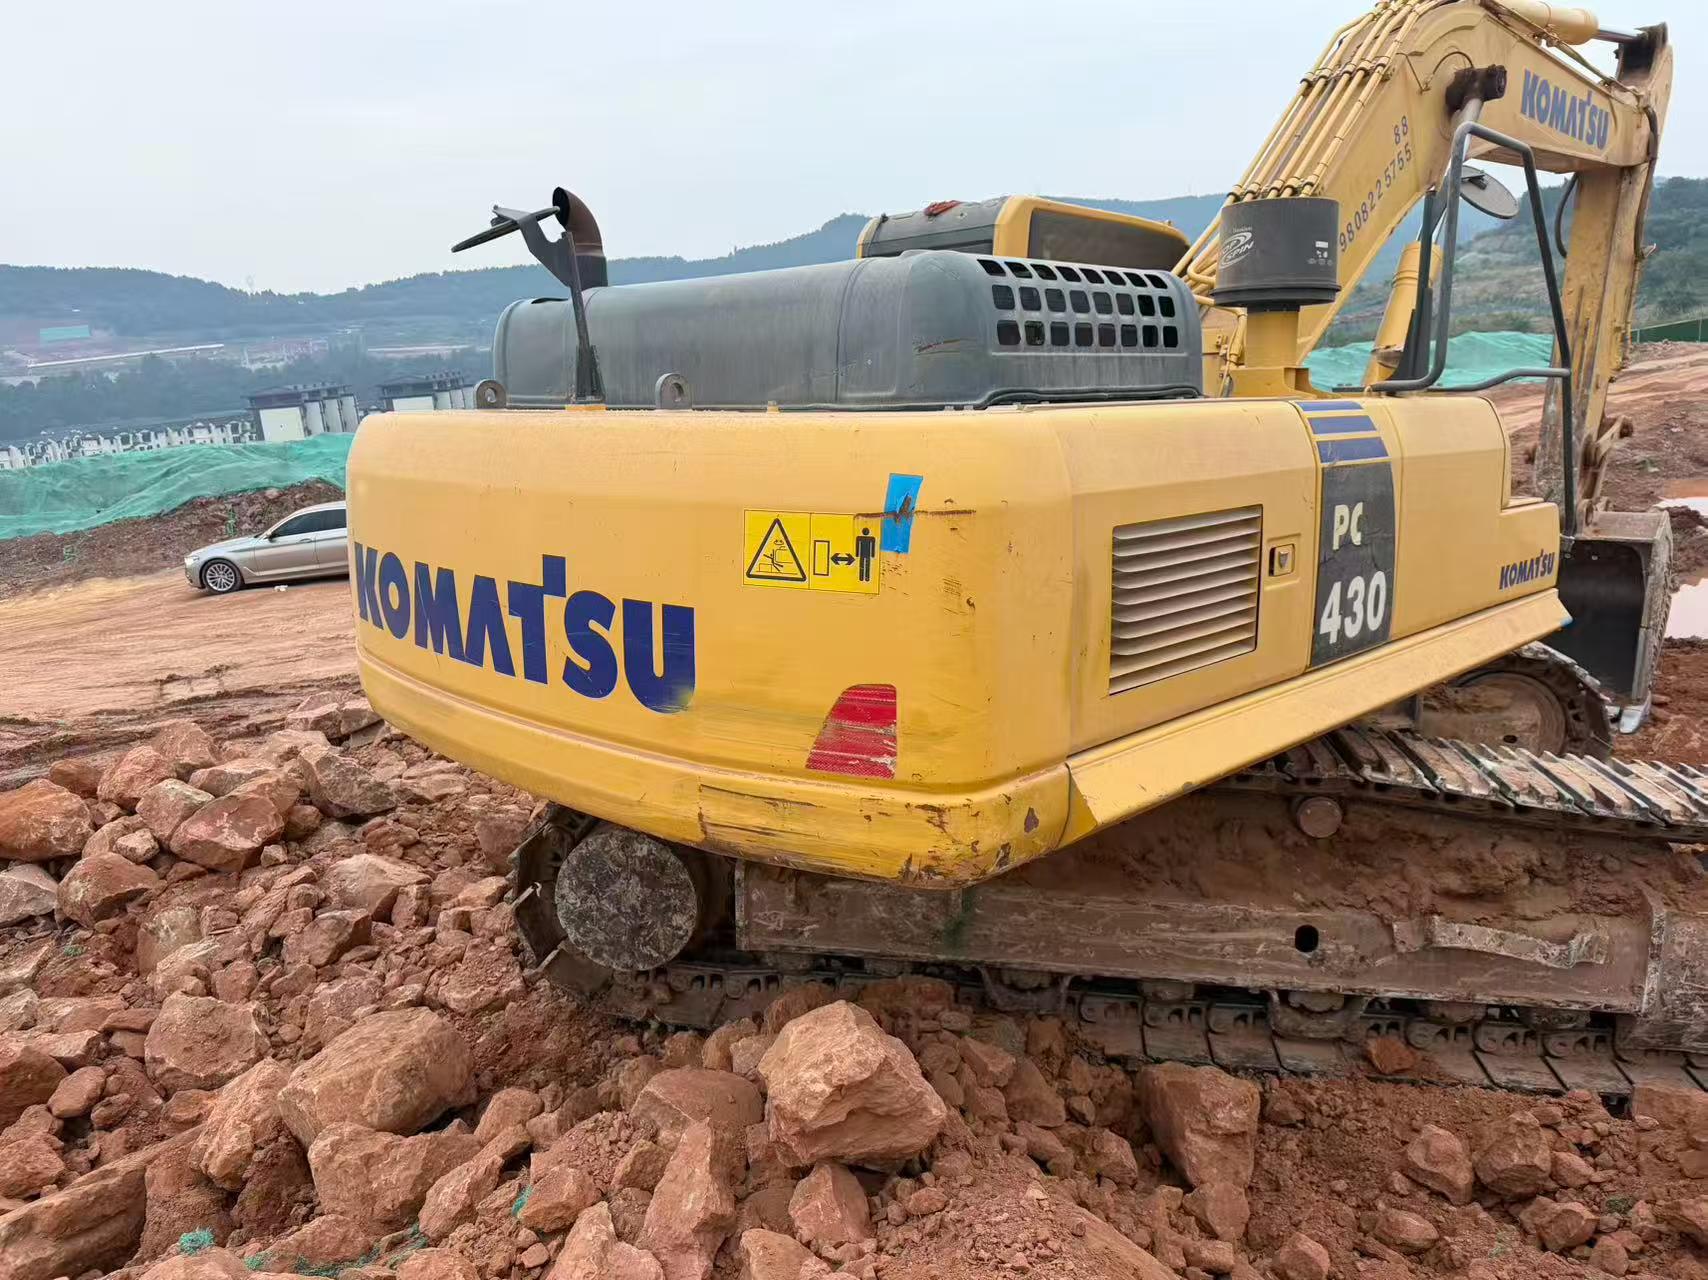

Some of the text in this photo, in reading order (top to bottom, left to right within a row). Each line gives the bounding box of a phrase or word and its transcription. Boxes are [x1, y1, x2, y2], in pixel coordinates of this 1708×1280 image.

[1393, 115, 1409, 144] 88
[1521, 69, 1609, 149] KOMATSU
[1332, 501, 1363, 550] PC
[1499, 549, 1555, 590] KOMATSU
[353, 541, 696, 714] KOMATSU
[1320, 570, 1386, 644] 430
